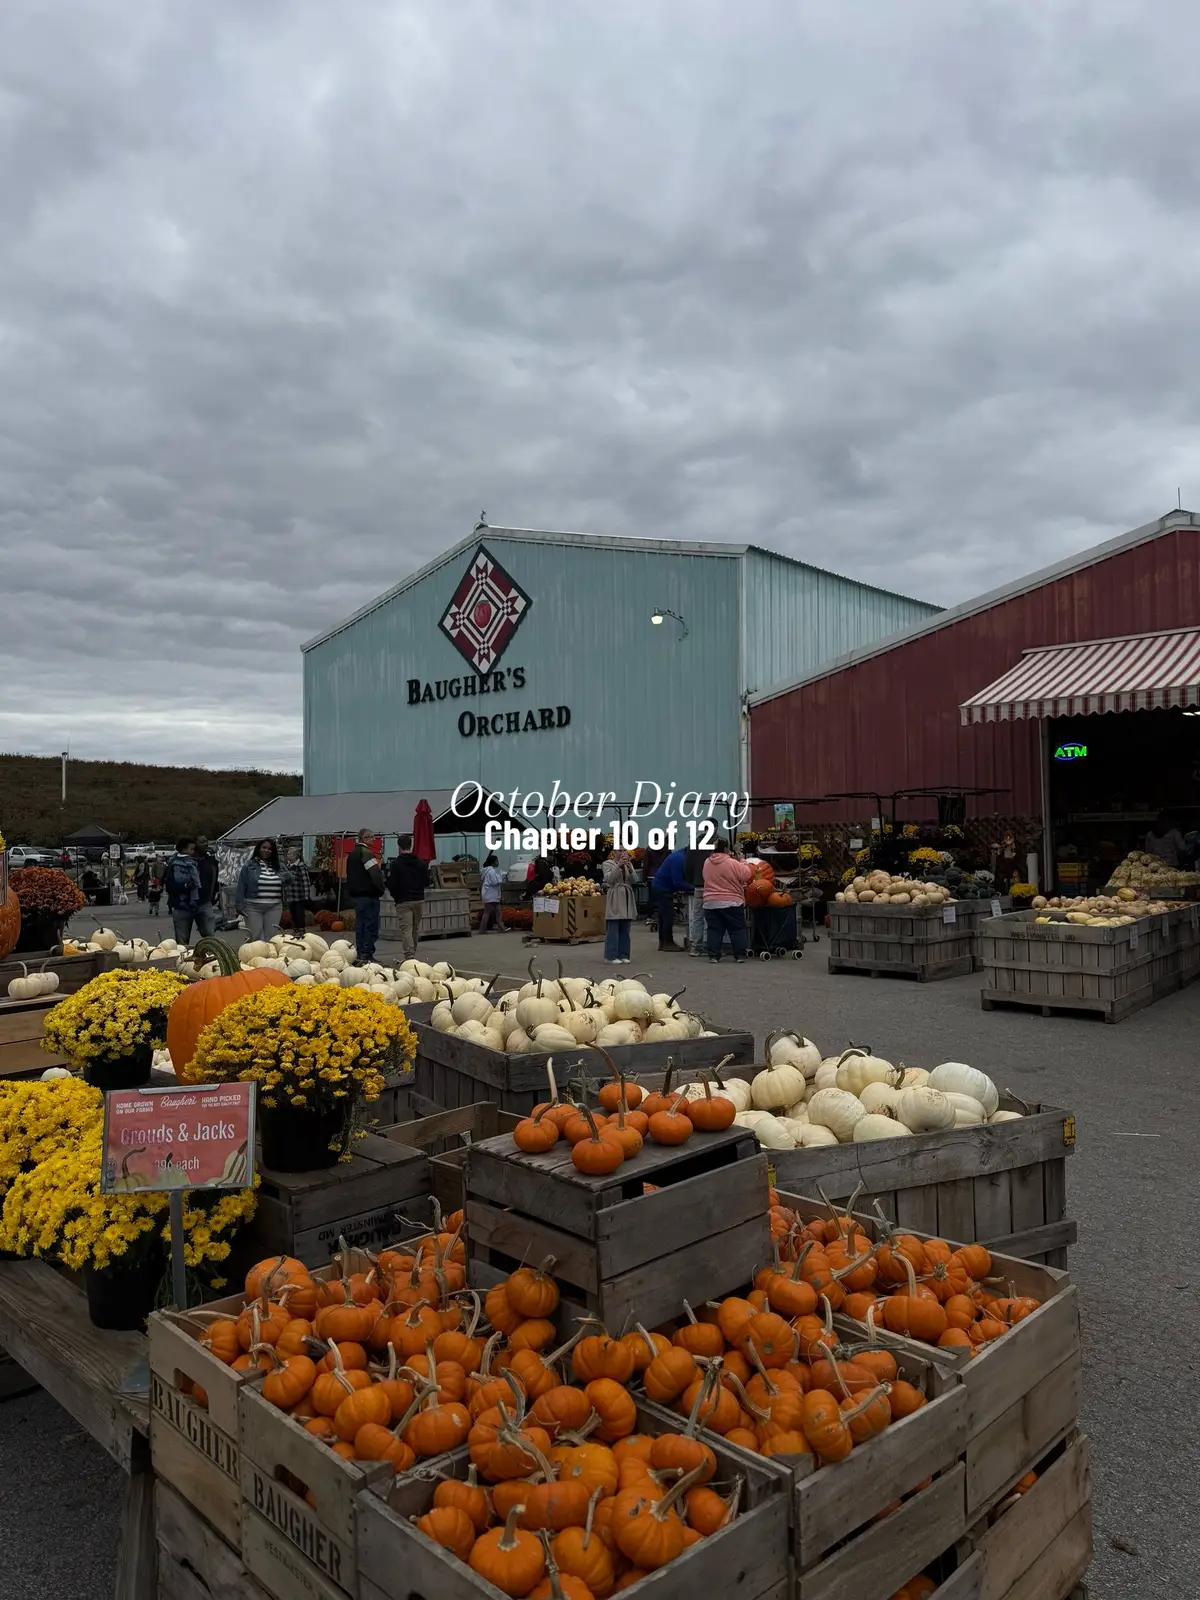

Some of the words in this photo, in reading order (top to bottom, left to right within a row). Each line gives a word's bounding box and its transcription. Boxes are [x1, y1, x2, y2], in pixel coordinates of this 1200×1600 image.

[406, 666, 527, 705] BAUGHER'S
[457, 705, 571, 737] ORCHARD
[1054, 745, 1088, 757] ATM
[177, 1122, 189, 1142] &
[193, 1119, 236, 1141] Jacks
[176, 1156, 200, 1171] each
[152, 1375, 240, 1482] BAUGHER
[253, 1471, 342, 1583] BAUGHER
